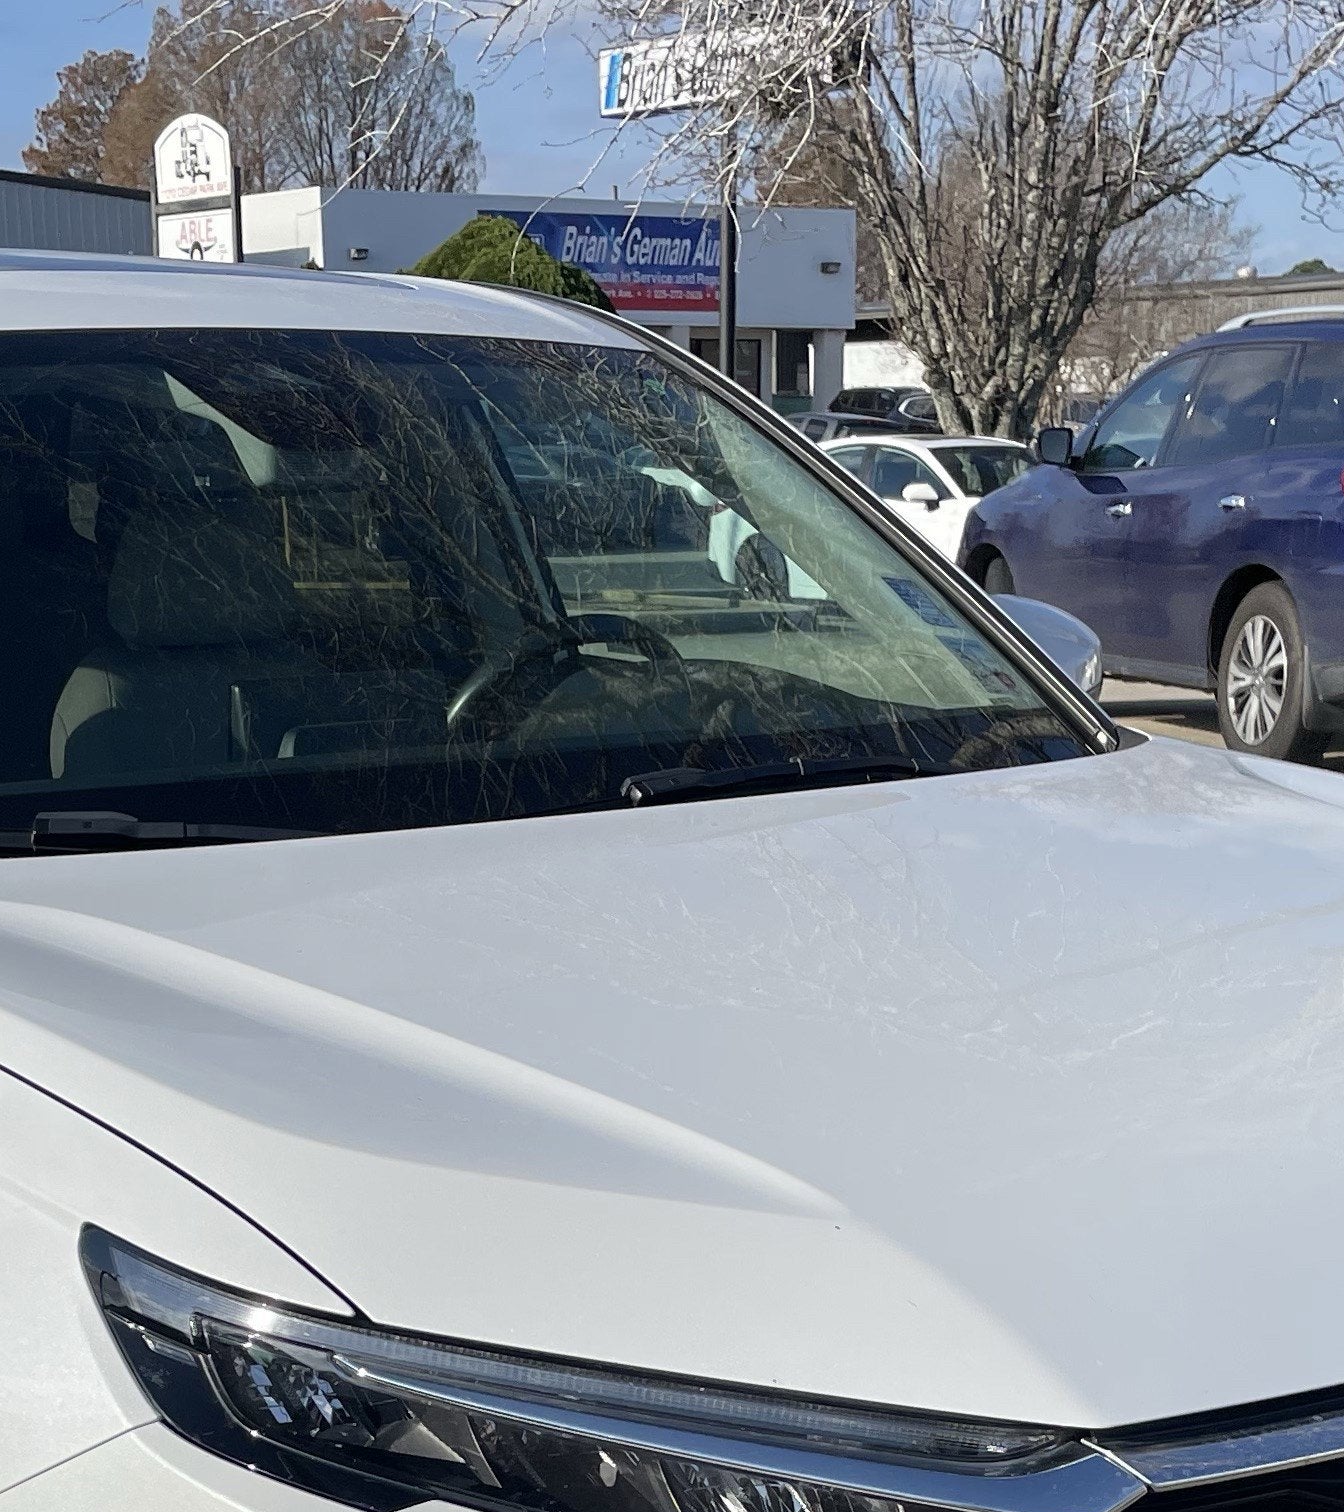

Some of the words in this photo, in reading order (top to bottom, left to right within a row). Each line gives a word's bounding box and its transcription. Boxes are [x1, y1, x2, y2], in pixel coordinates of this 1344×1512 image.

[180, 217, 214, 243] ABLE
[562, 225, 623, 264] Brian's
[625, 226, 691, 266] German
[633, 270, 673, 285] Service
